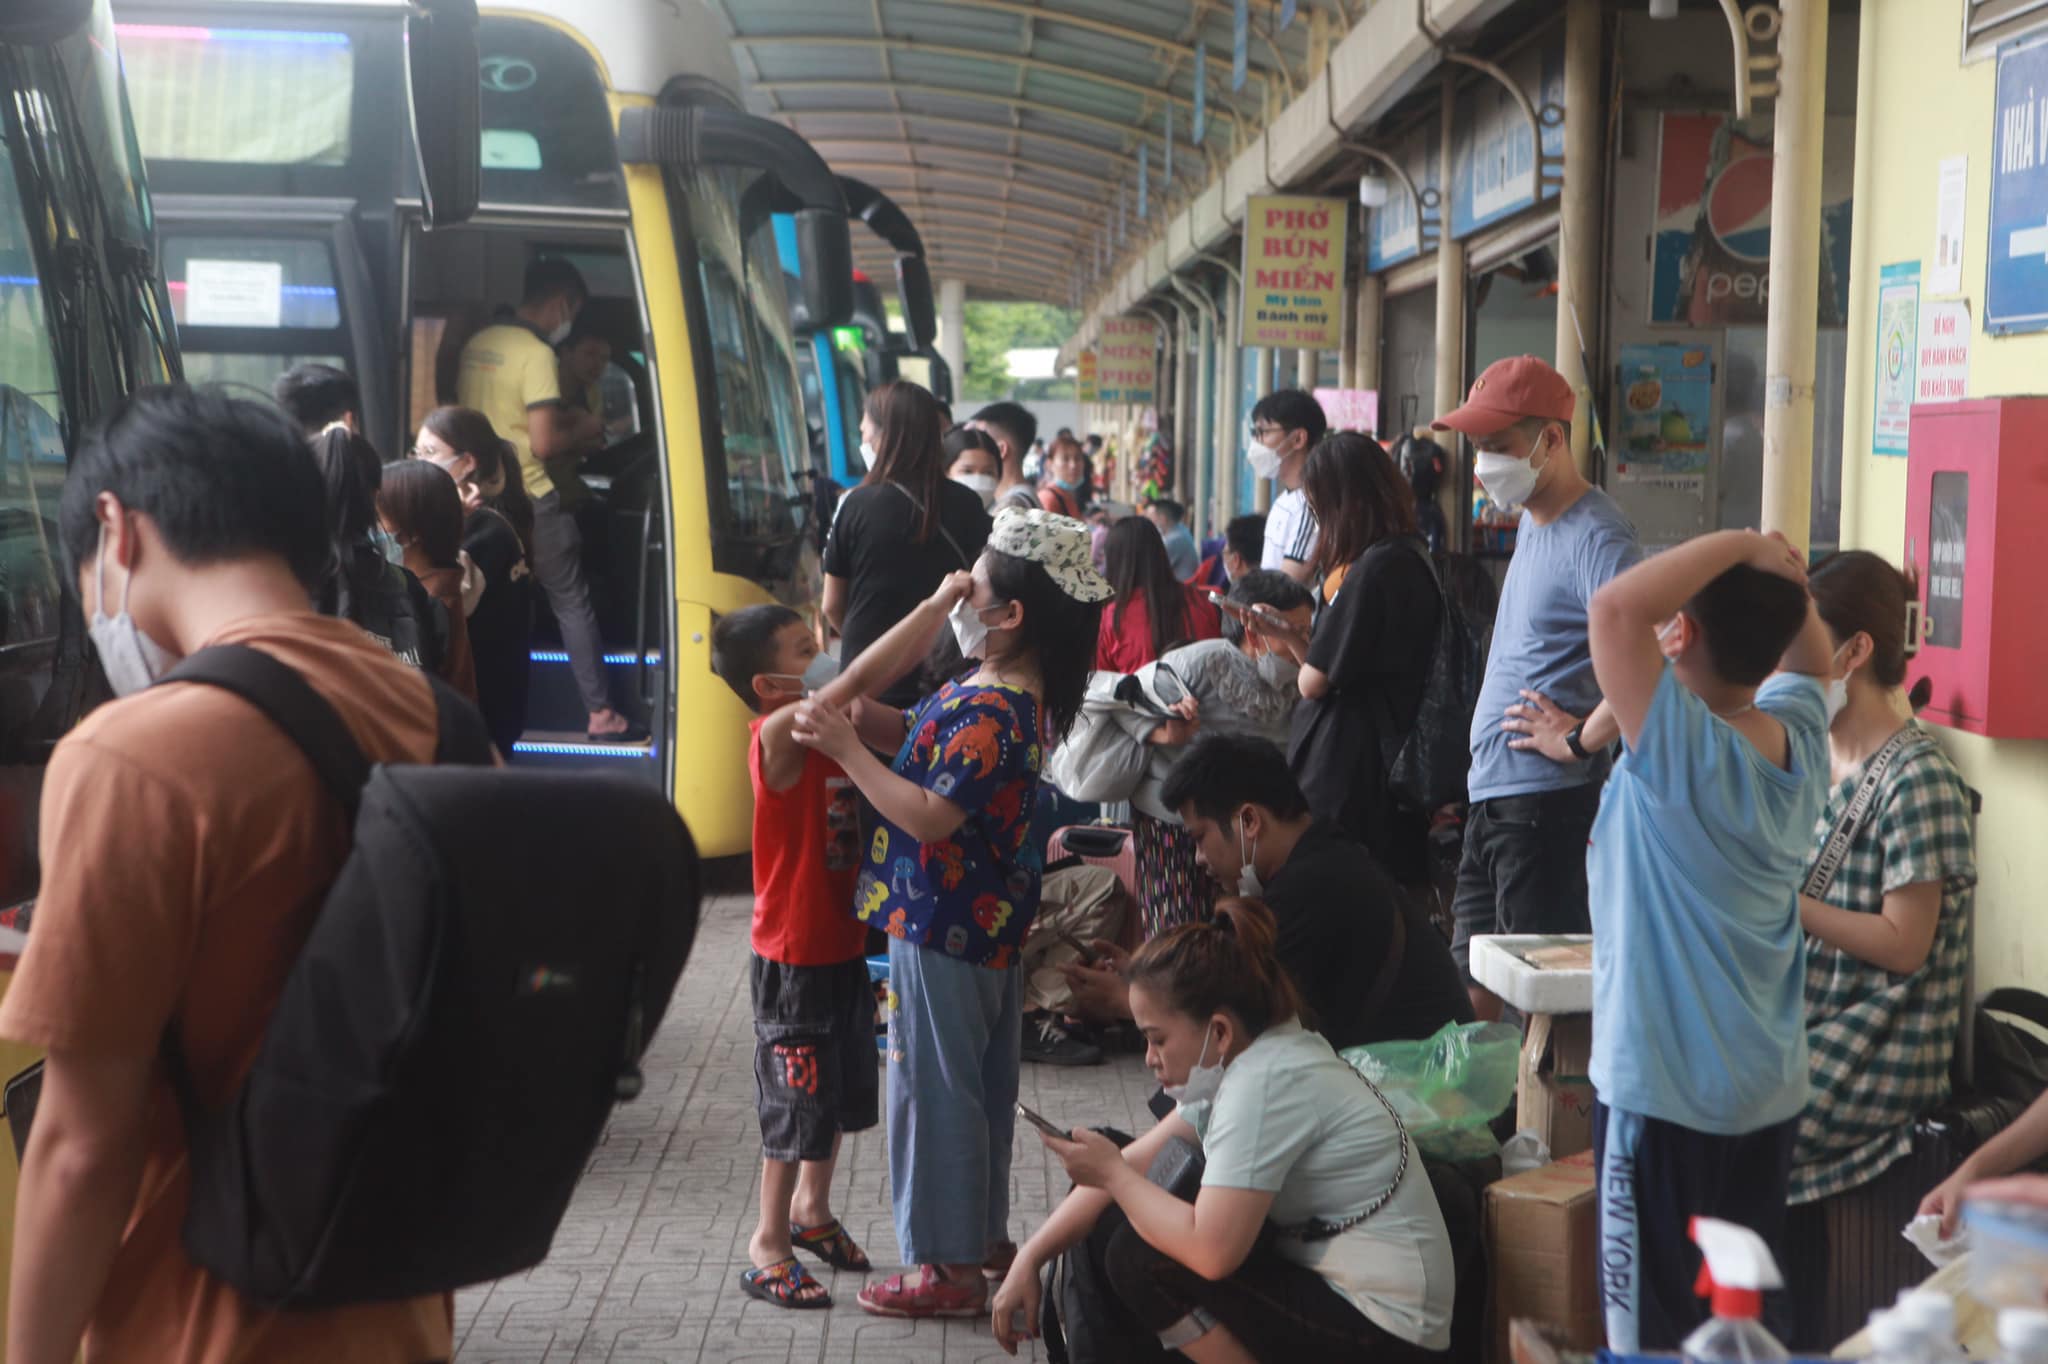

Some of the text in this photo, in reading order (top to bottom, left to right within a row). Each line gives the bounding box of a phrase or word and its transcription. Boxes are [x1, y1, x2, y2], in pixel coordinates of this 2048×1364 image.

[2002, 87, 2034, 174] NHÀ
[1265, 202, 1330, 230] PHỞ
[1263, 232, 1330, 260] BÚN
[786, 1056, 817, 1095] DJ
[1604, 1154, 1635, 1313] NEW YORK
